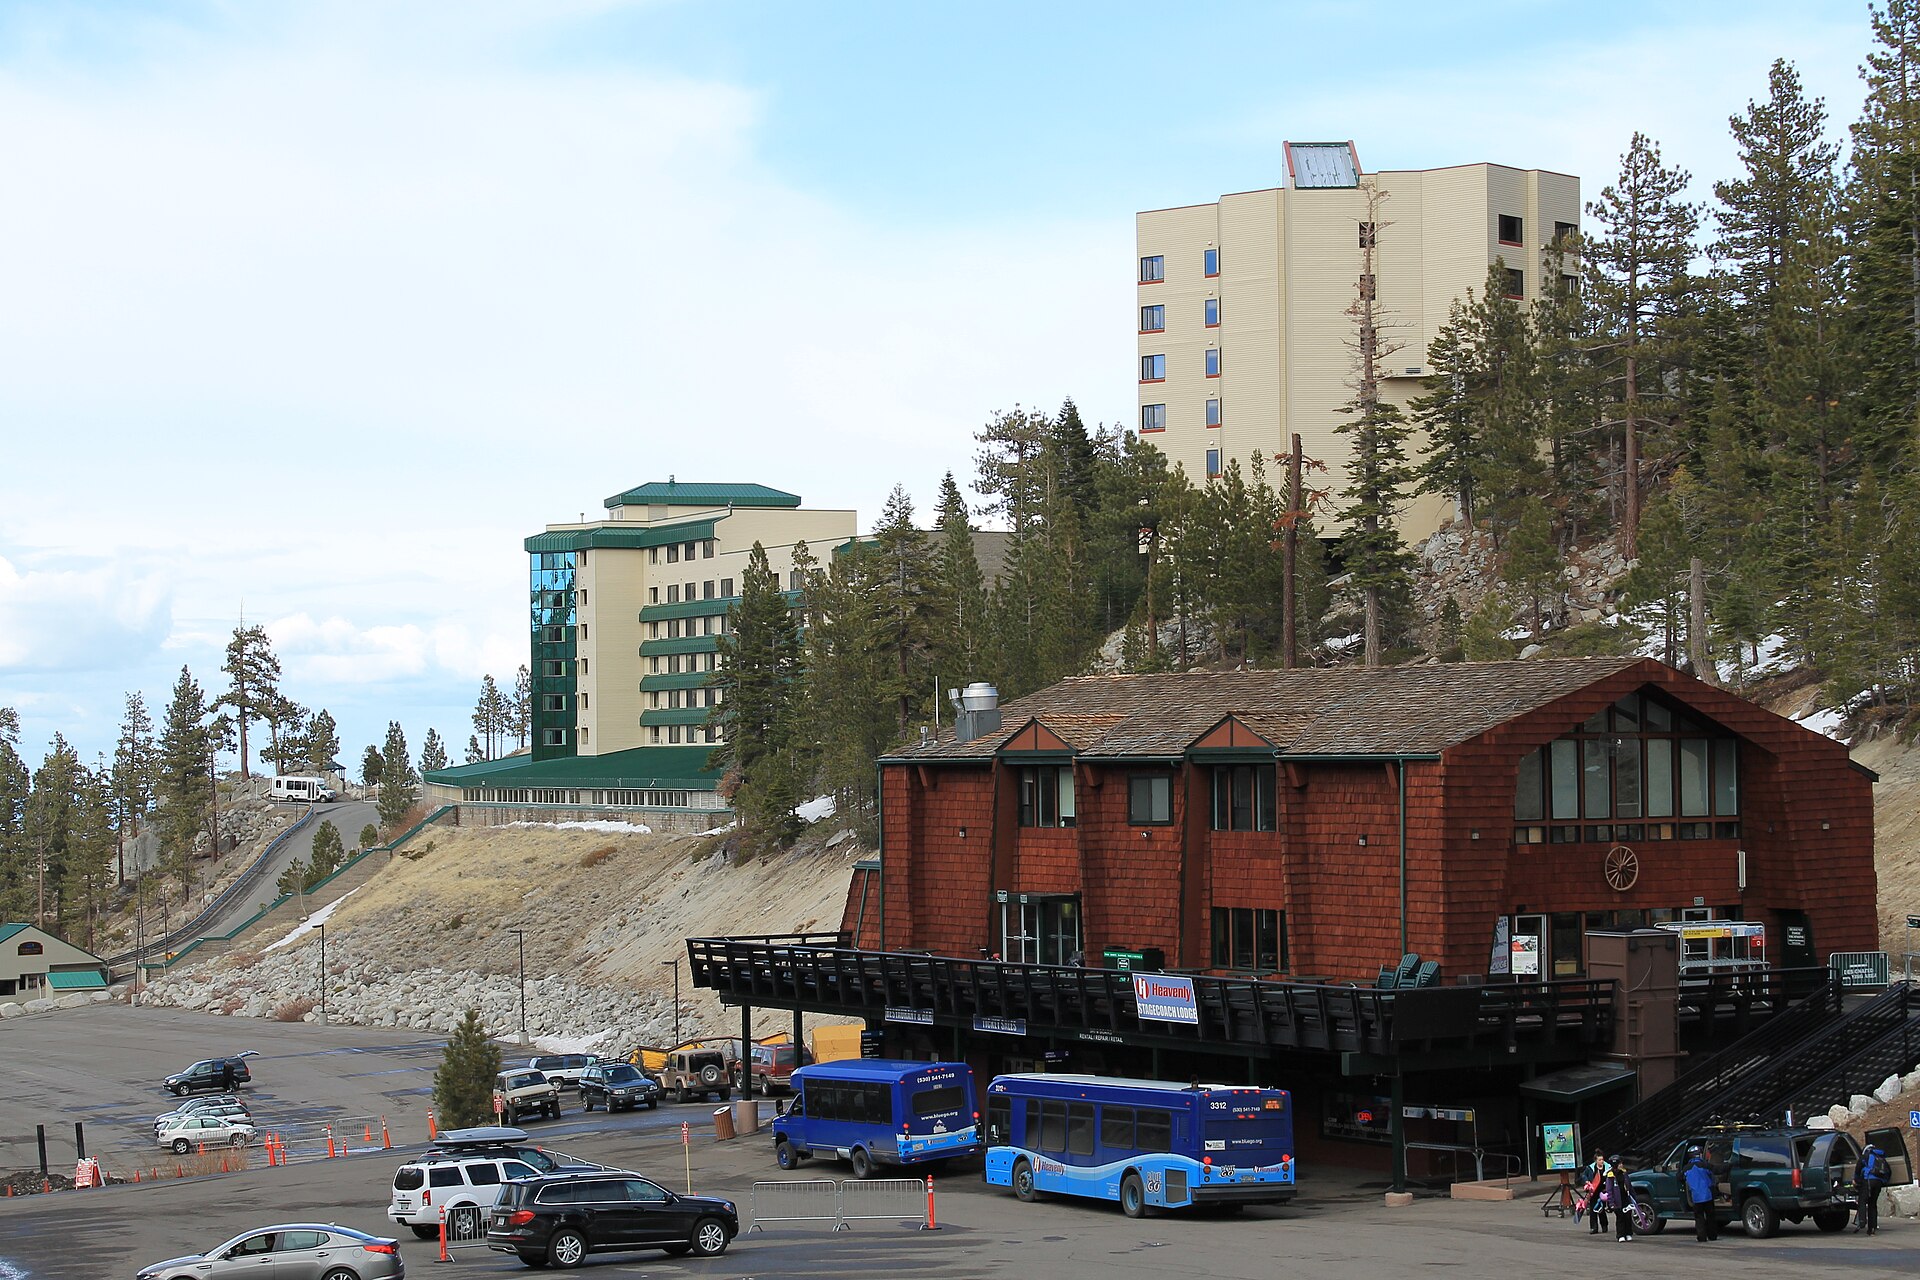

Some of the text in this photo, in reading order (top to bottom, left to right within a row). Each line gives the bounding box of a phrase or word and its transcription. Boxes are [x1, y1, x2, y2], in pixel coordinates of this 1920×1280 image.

[1152, 983, 1191, 1002] Heavenly
[1138, 1002, 1198, 1019] STAGECOACH LODGE
[1209, 1101, 1227, 1110] 3312
[920, 1111, 959, 1121] www.bluego.org
[1357, 1112, 1373, 1121] OPEN
[1041, 1161, 1067, 1176] Heavenly
[1146, 1180, 1162, 1193] GO
